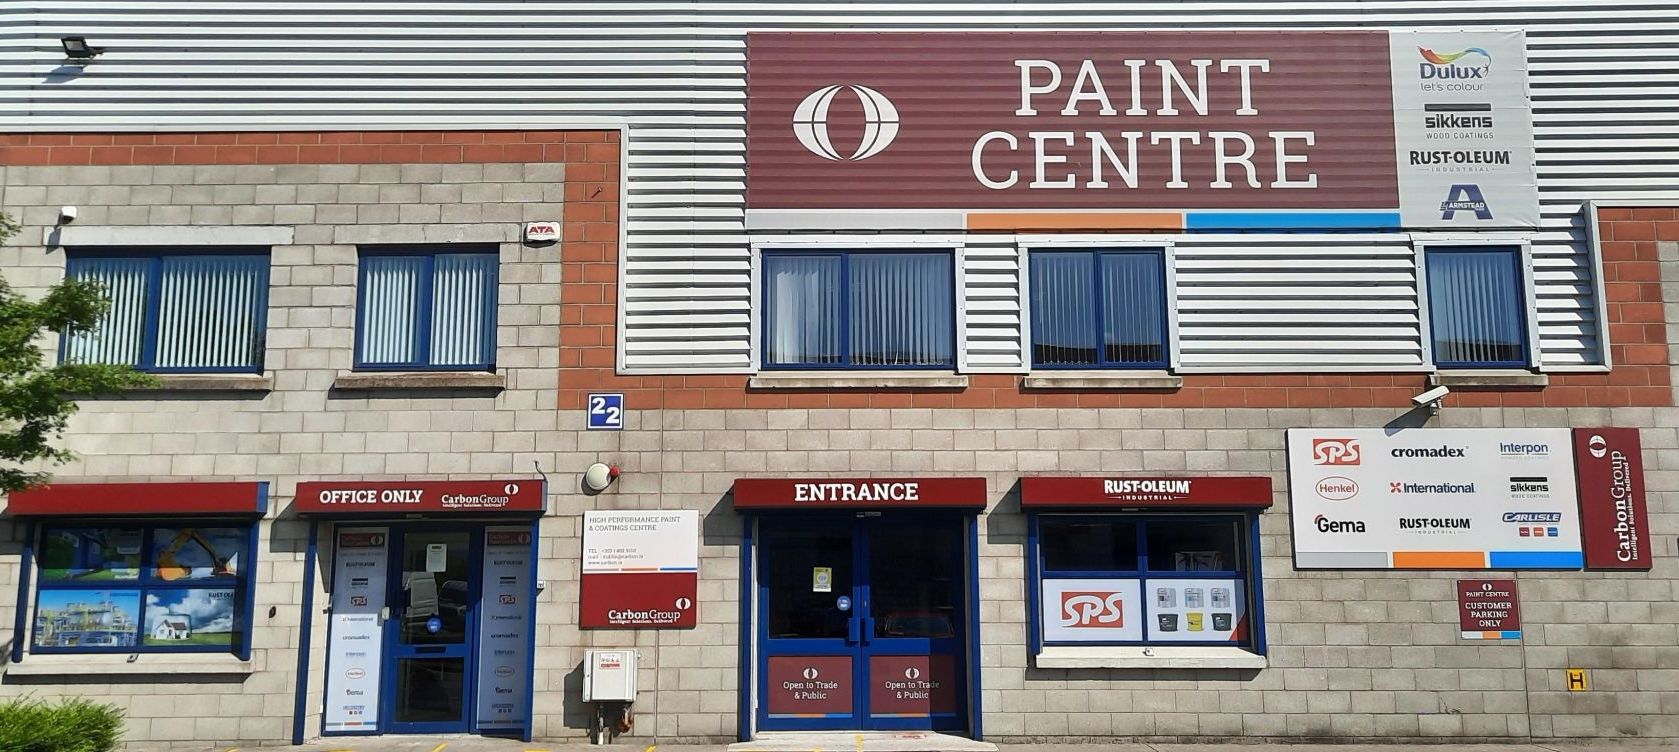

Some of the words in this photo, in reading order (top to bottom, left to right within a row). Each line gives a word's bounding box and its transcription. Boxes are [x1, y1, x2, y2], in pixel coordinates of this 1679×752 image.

[1420, 63, 1482, 79] Dulux
[1014, 59, 1271, 117] PAINT
[1421, 83, 1443, 91] let's
[1447, 83, 1483, 91] colour
[1425, 114, 1493, 128] sikkens
[971, 130, 1318, 189] CENTRE
[1409, 151, 1510, 165] RUST-OLEUM
[591, 397, 620, 423] 22
[1313, 439, 1360, 465] SPS
[1391, 445, 1465, 458] cromadex
[1500, 442, 1548, 455] Interpon
[1624, 462, 1632, 492] Delivered
[795, 483, 919, 501] ENTRANCE
[1104, 480, 1190, 494] RUST-OLEUM
[1319, 484, 1355, 493] Henkel
[1403, 482, 1475, 493] International
[1510, 483, 1549, 492] sikkens
[320, 490, 377, 504] OFFICE
[381, 490, 423, 503] ONLY
[441, 494, 509, 506] CarbonGroup
[1399, 518, 1471, 529] RUST-OLEUM
[1503, 512, 1561, 522] CARLISLE
[1317, 517, 1366, 533] Gema
[1629, 526, 1638, 560] Intelligent
[608, 609, 680, 622] CarbonGroup
[1062, 591, 1123, 627] SPS
[783, 681, 804, 690] Open
[816, 681, 838, 689] Trade
[885, 681, 906, 690] Open
[917, 681, 940, 689] Trade
[1570, 672, 1583, 689] H
[802, 691, 827, 700] Public
[904, 691, 929, 699] Public
